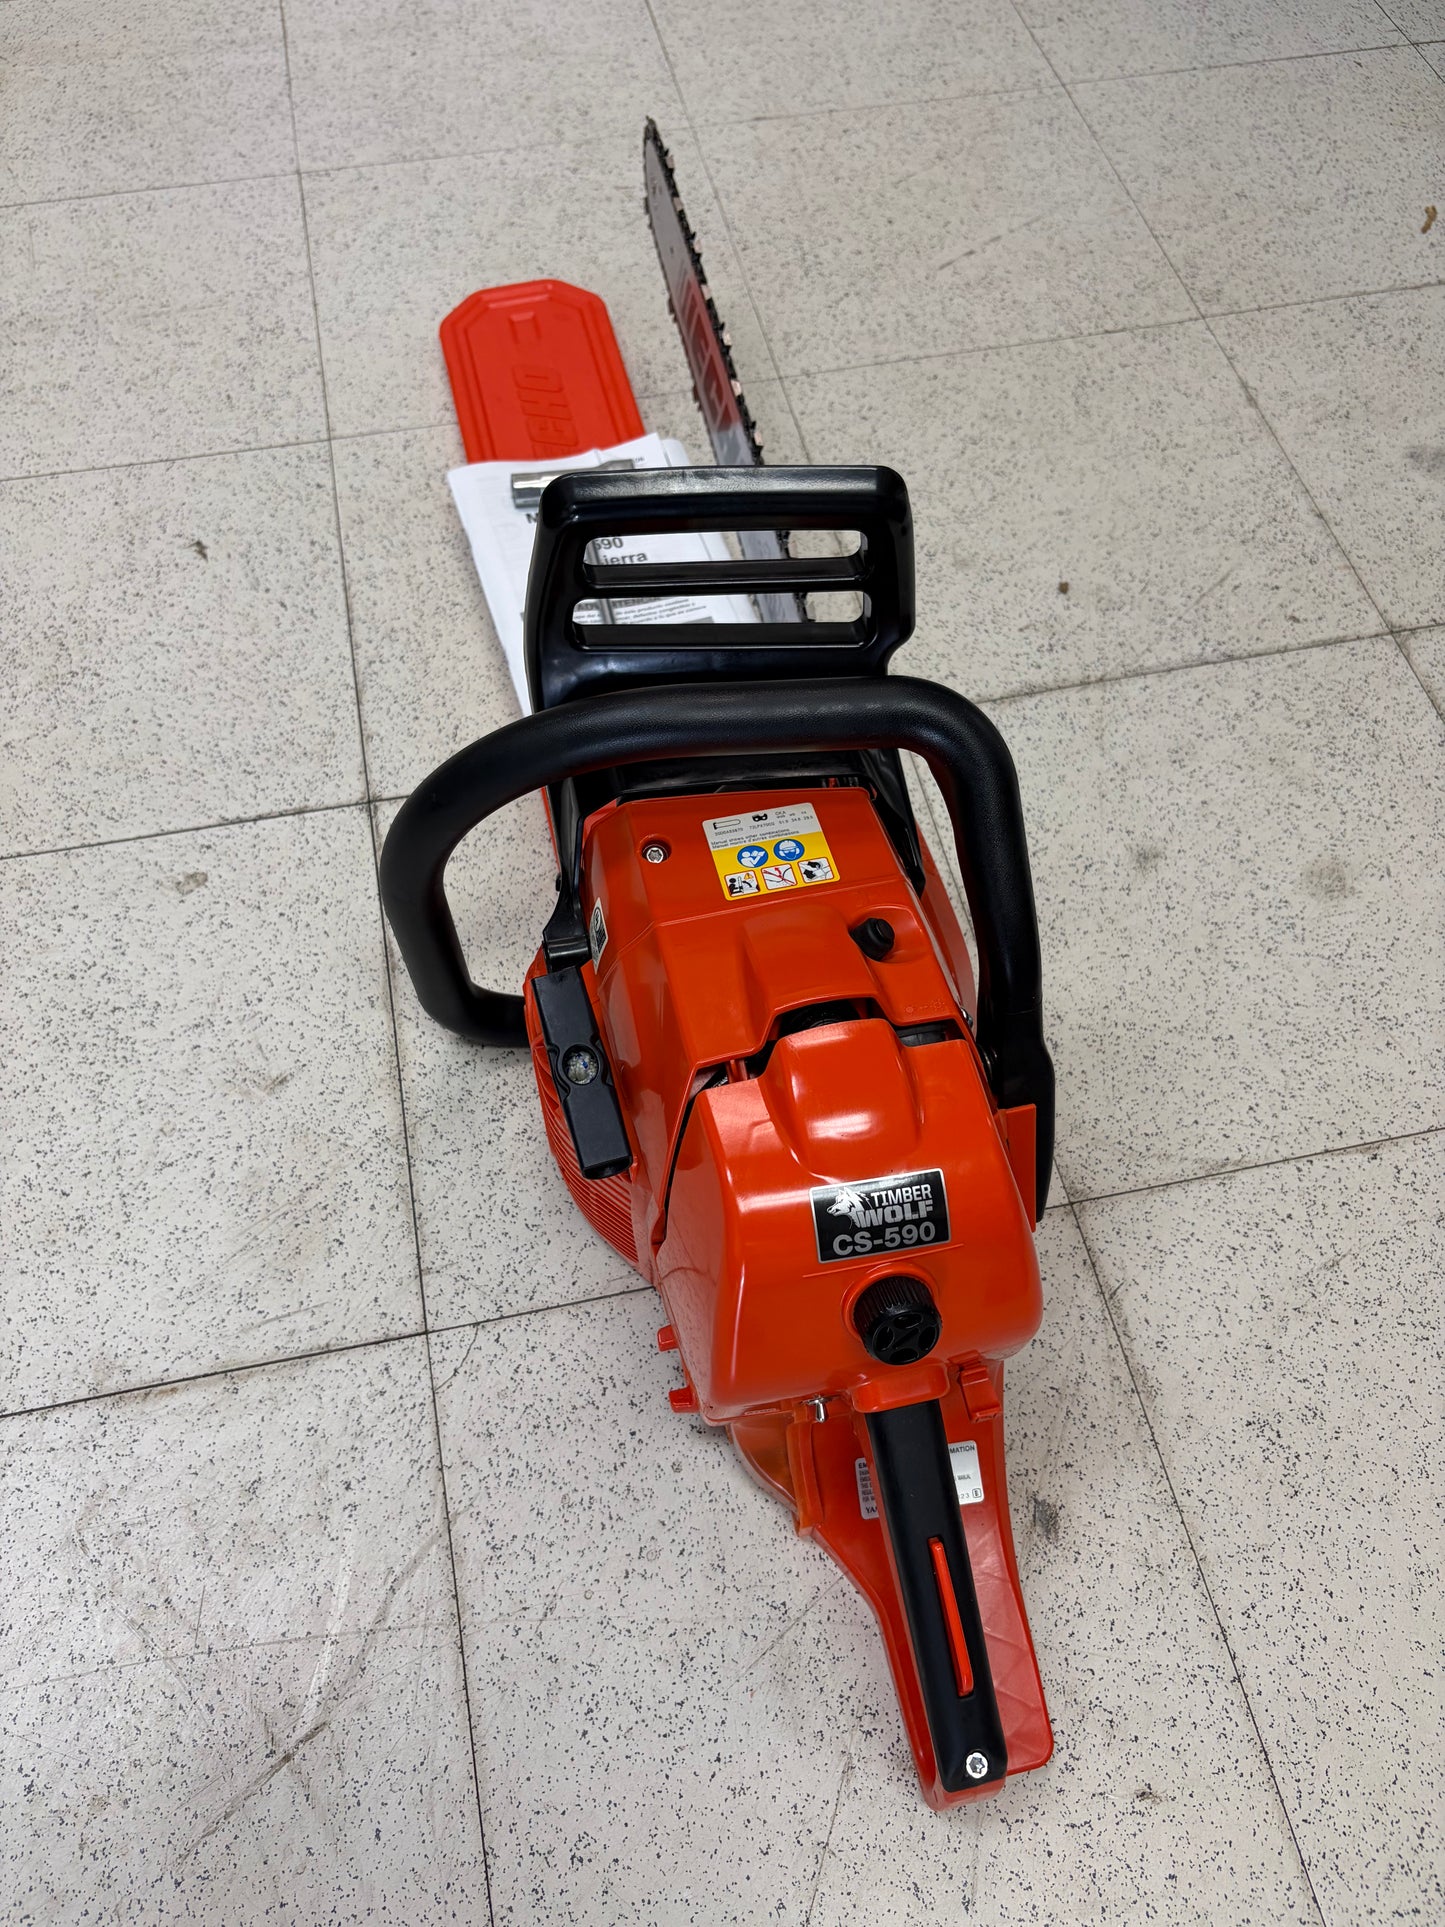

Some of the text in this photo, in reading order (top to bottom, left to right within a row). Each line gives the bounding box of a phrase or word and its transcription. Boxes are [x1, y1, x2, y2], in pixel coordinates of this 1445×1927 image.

[601, 553, 648, 565] ierra
[871, 1184, 933, 1207] TIMBER
[855, 1200, 934, 1229] WOLF
[832, 1221, 936, 1256] CS-590
[949, 1445, 975, 1454] MATION
